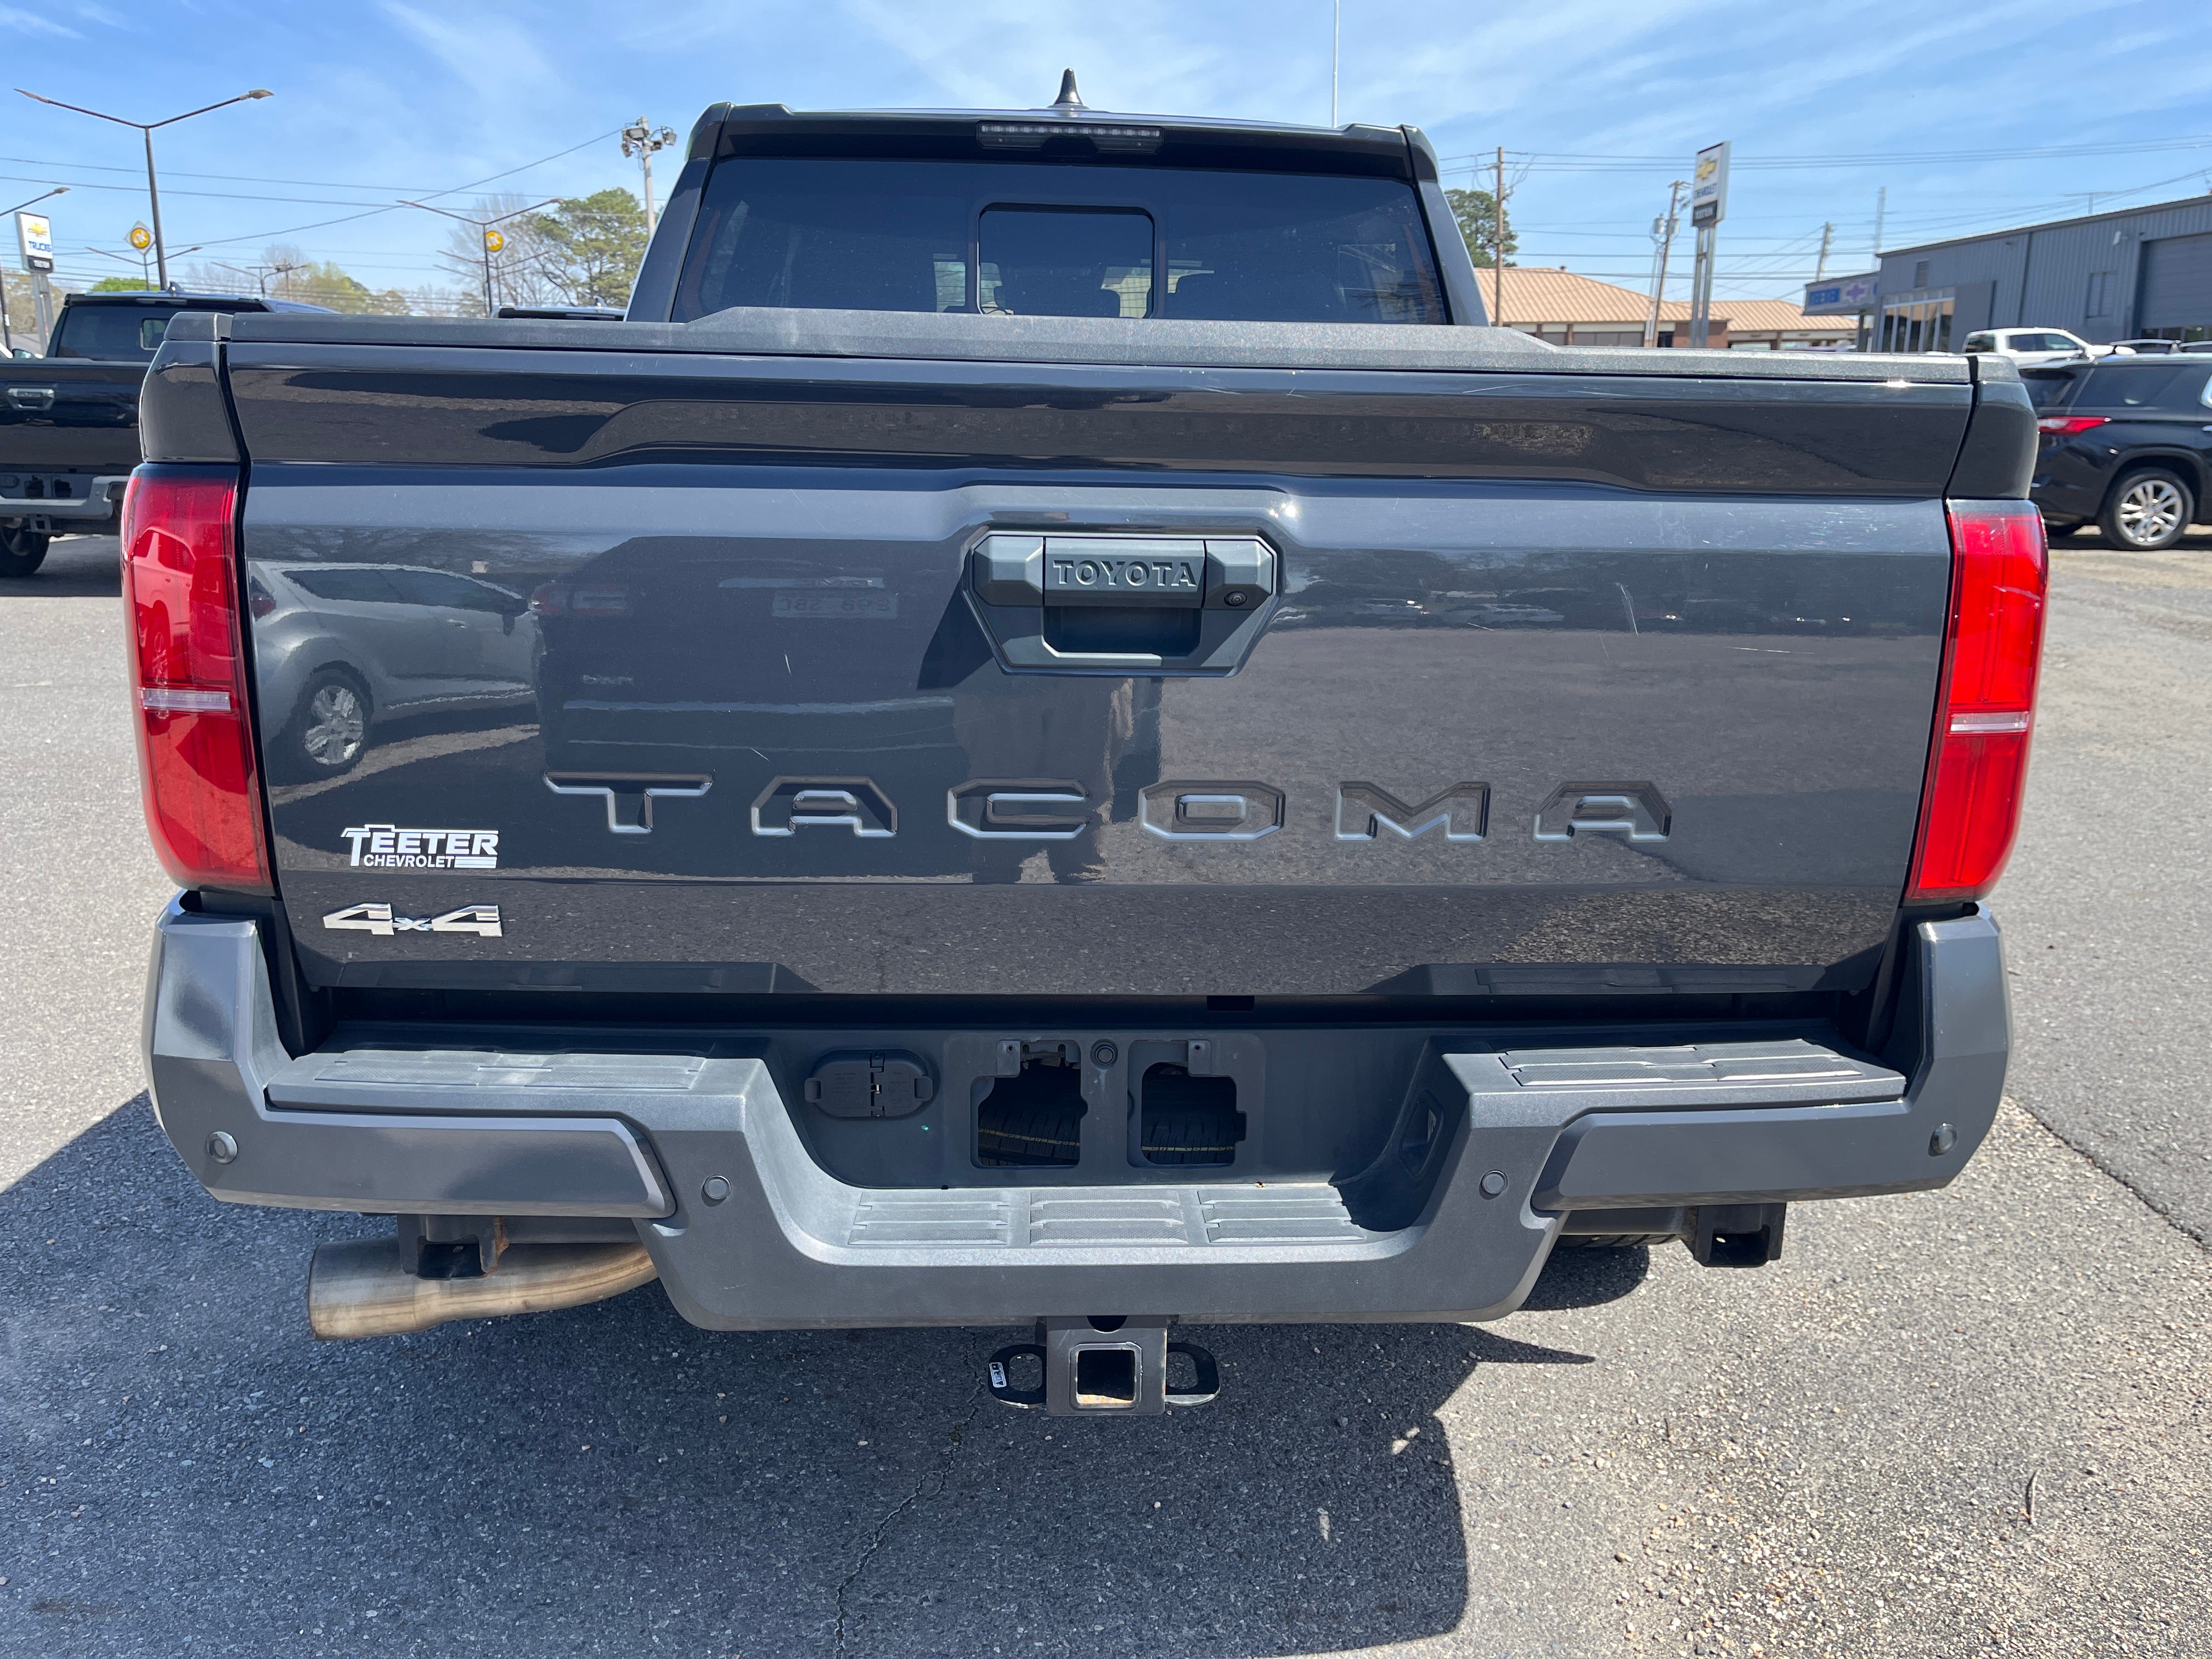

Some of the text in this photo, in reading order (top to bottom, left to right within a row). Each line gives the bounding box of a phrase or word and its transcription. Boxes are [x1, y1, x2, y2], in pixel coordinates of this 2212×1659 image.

[1053, 560, 1197, 587] TOYOTA
[544, 771, 1672, 842] TACOMA
[341, 826, 499, 866] TEETER
[363, 854, 455, 868] CHEVROLET
